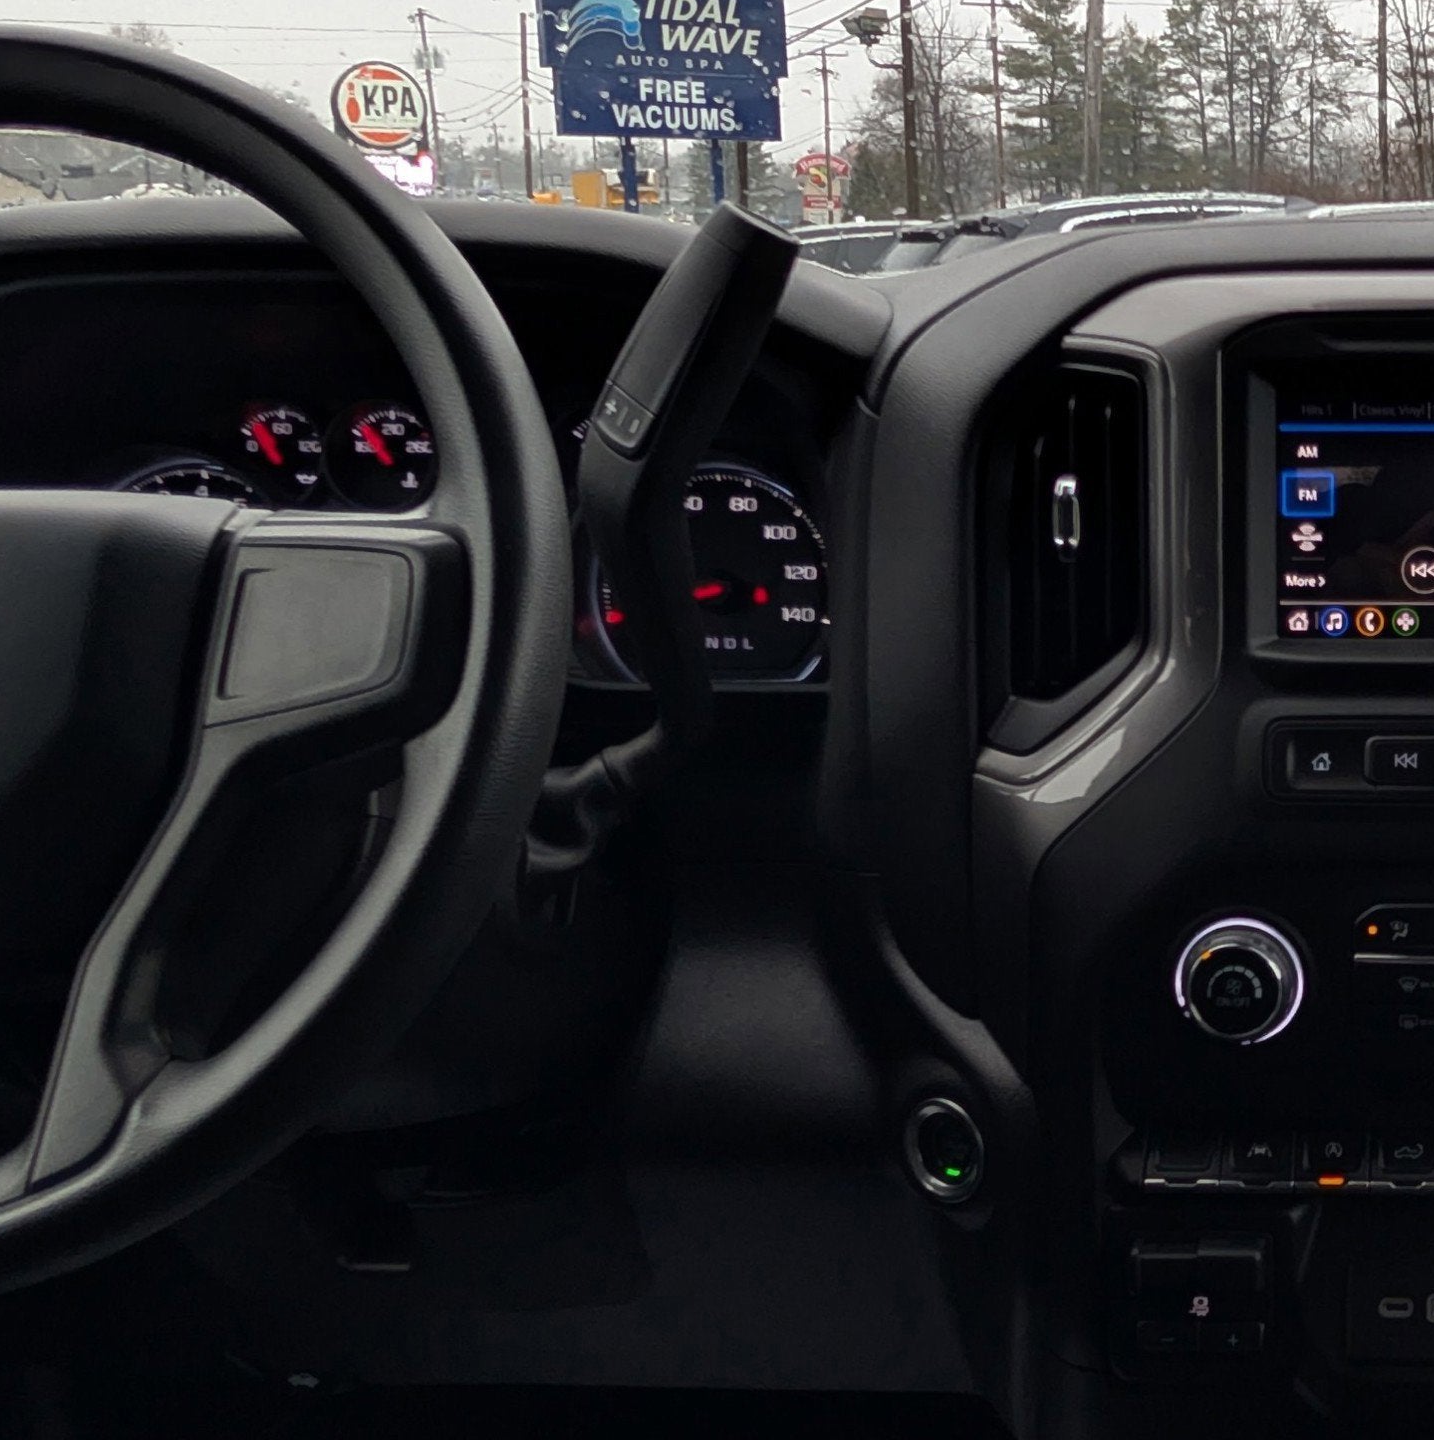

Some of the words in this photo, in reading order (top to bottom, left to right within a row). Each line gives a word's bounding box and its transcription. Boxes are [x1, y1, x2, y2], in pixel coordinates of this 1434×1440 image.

[660, 24, 762, 56] WAVE
[615, 55, 670, 68] AUTO
[684, 58, 724, 71] SPA
[638, 78, 707, 104] FREE
[361, 85, 418, 118] KPA
[611, 104, 737, 132] VACUUMS
[1297, 445, 1319, 459] AM
[1298, 488, 1318, 502] FM
[728, 496, 758, 512] 80
[762, 524, 798, 540] 100
[783, 564, 818, 581] 120
[1285, 575, 1316, 588] More
[780, 607, 816, 622] 140
[704, 636, 719, 649] N
[723, 636, 737, 649] D
[742, 637, 755, 650] L
